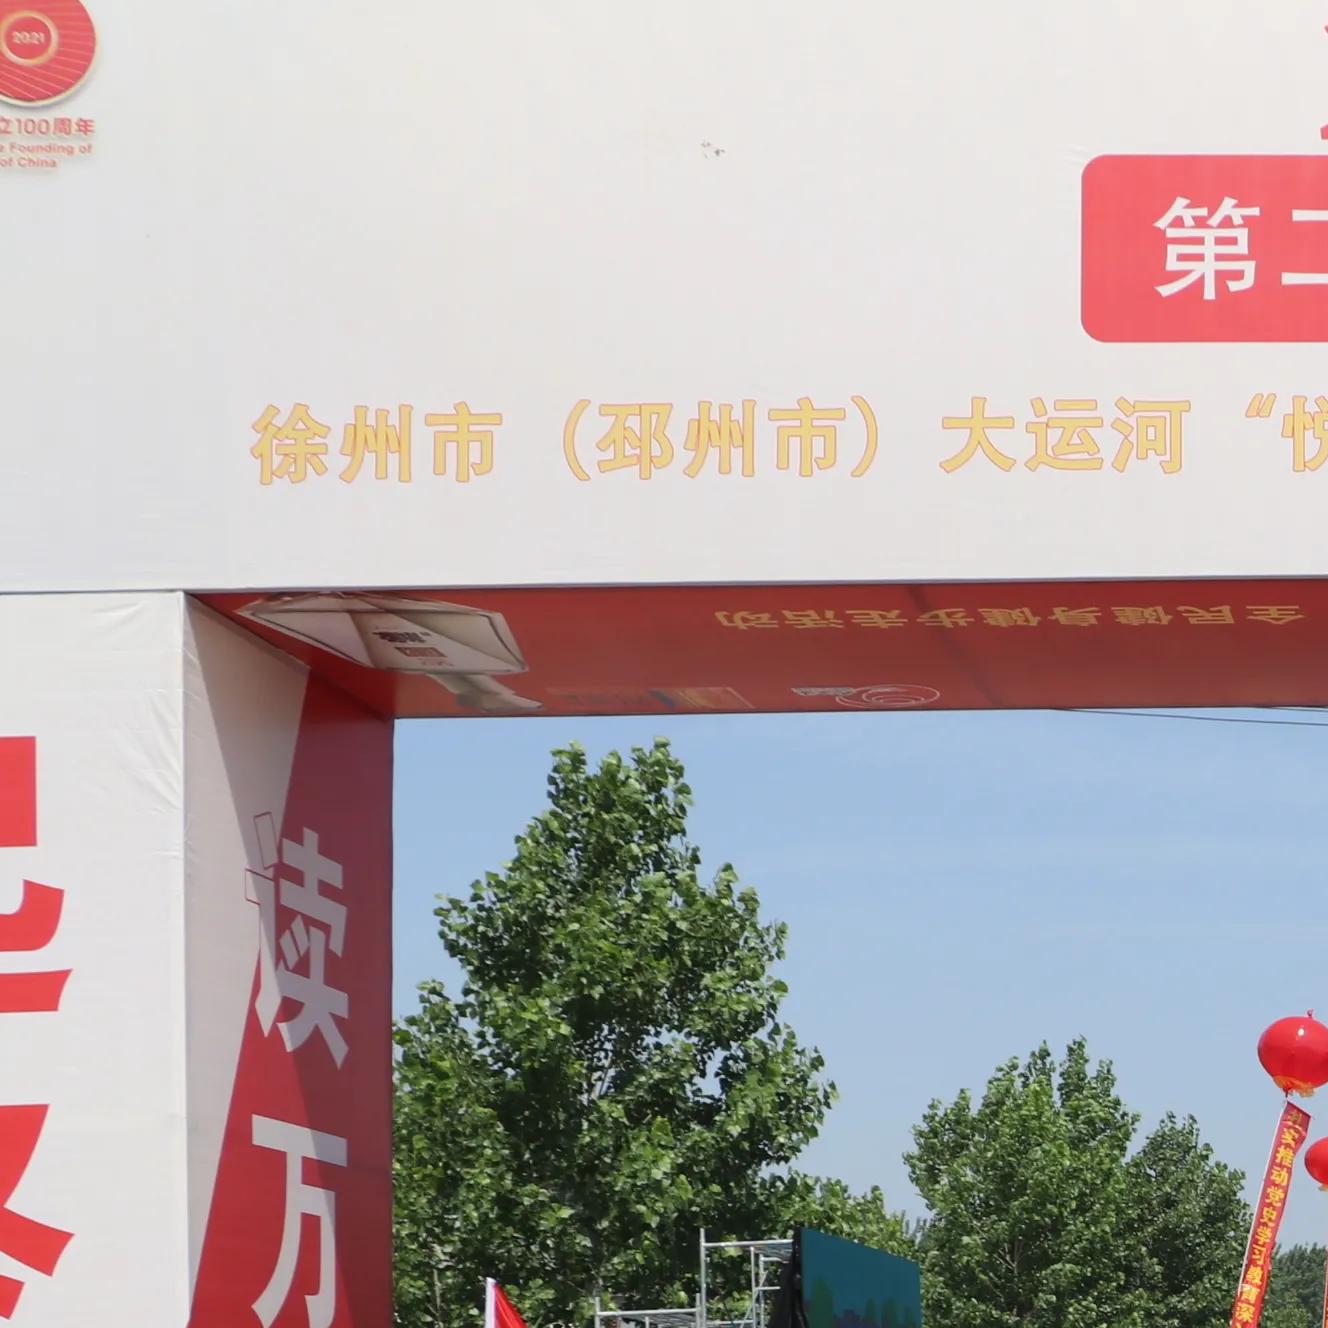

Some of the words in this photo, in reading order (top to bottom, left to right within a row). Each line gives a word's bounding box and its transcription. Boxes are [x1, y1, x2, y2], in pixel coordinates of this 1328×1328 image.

[9, 141, 74, 155] Founding
[79, 142, 92, 154] of
[18, 157, 57, 168] China
